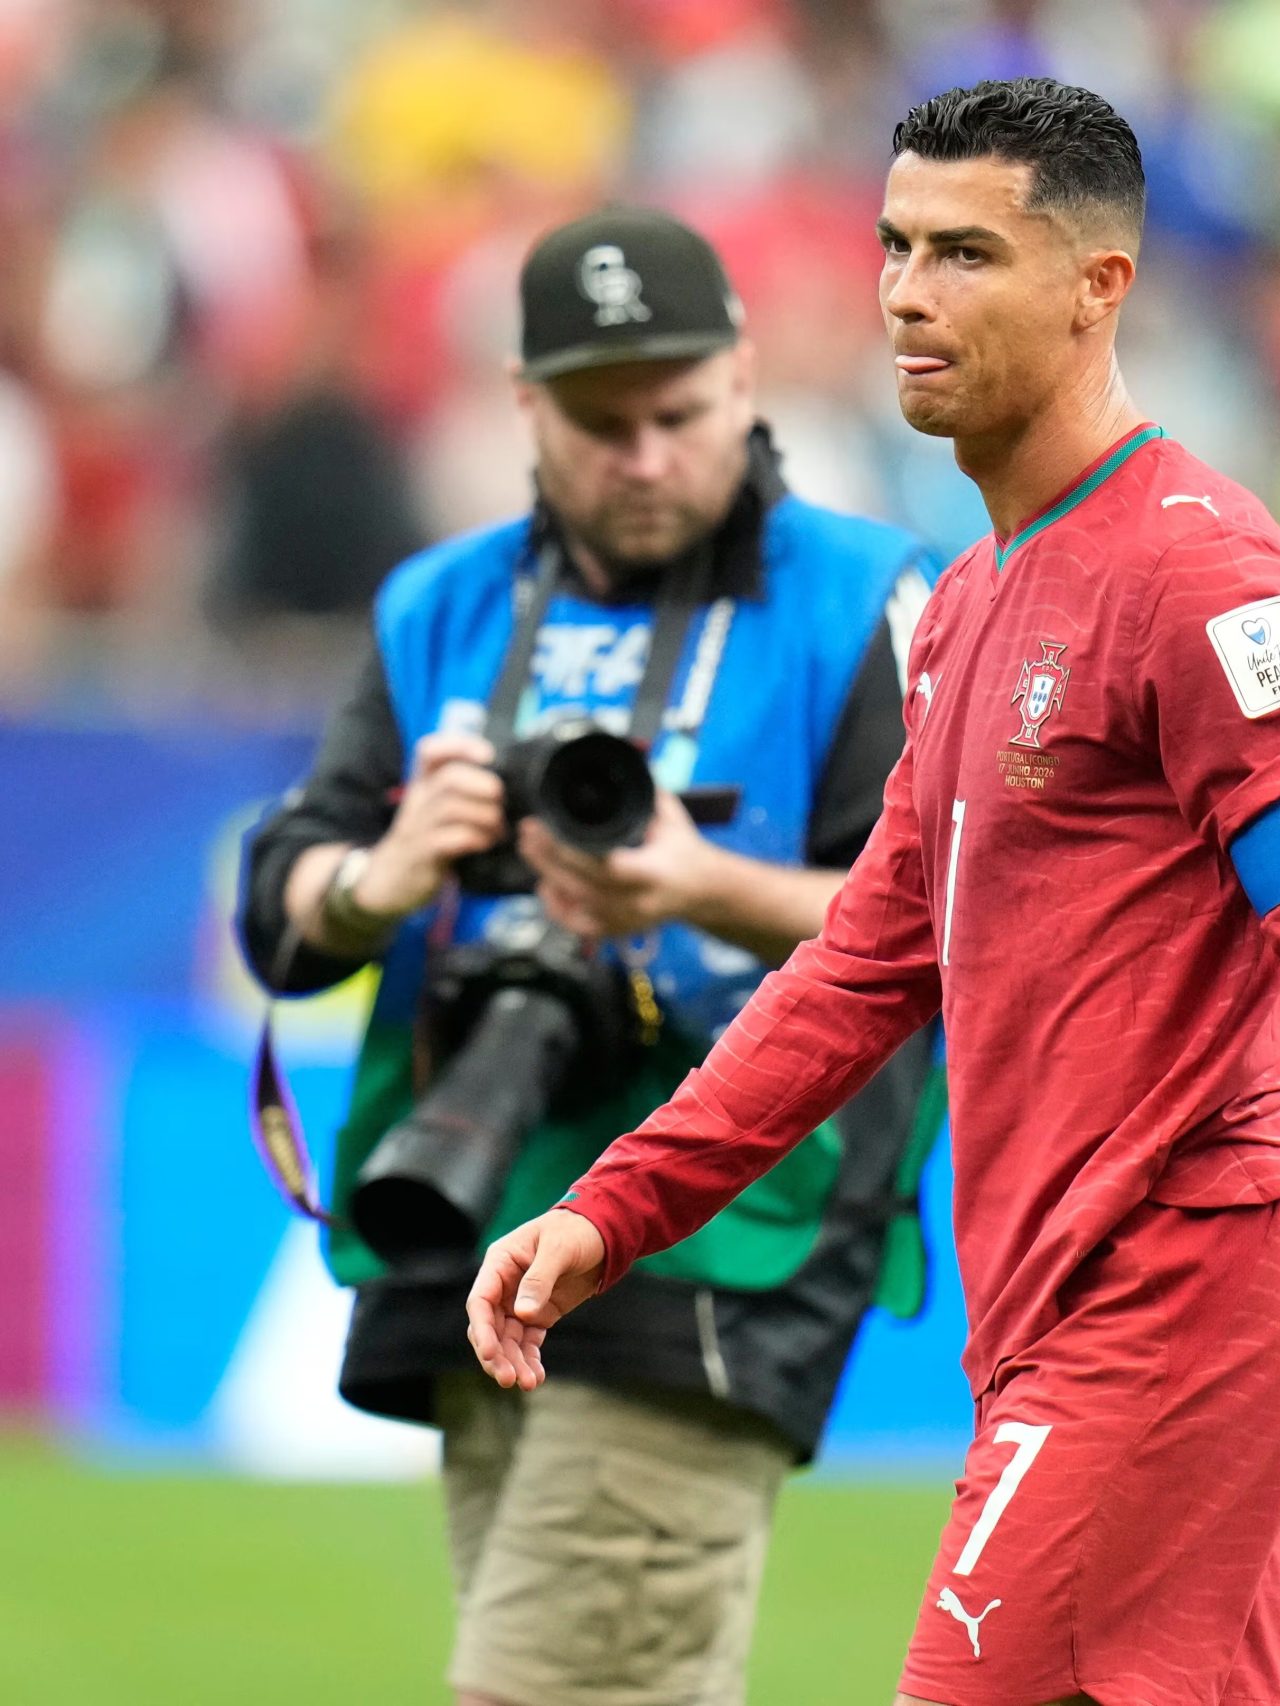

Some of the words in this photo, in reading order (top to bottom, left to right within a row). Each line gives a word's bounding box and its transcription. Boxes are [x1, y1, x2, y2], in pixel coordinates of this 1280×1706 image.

[998, 763, 1006, 774] 17
[1007, 764, 1031, 776] JUNHO
[1033, 766, 1055, 778] 2026
[1005, 775, 1045, 789] HOUSTON
[952, 1421, 1054, 1577] 7
